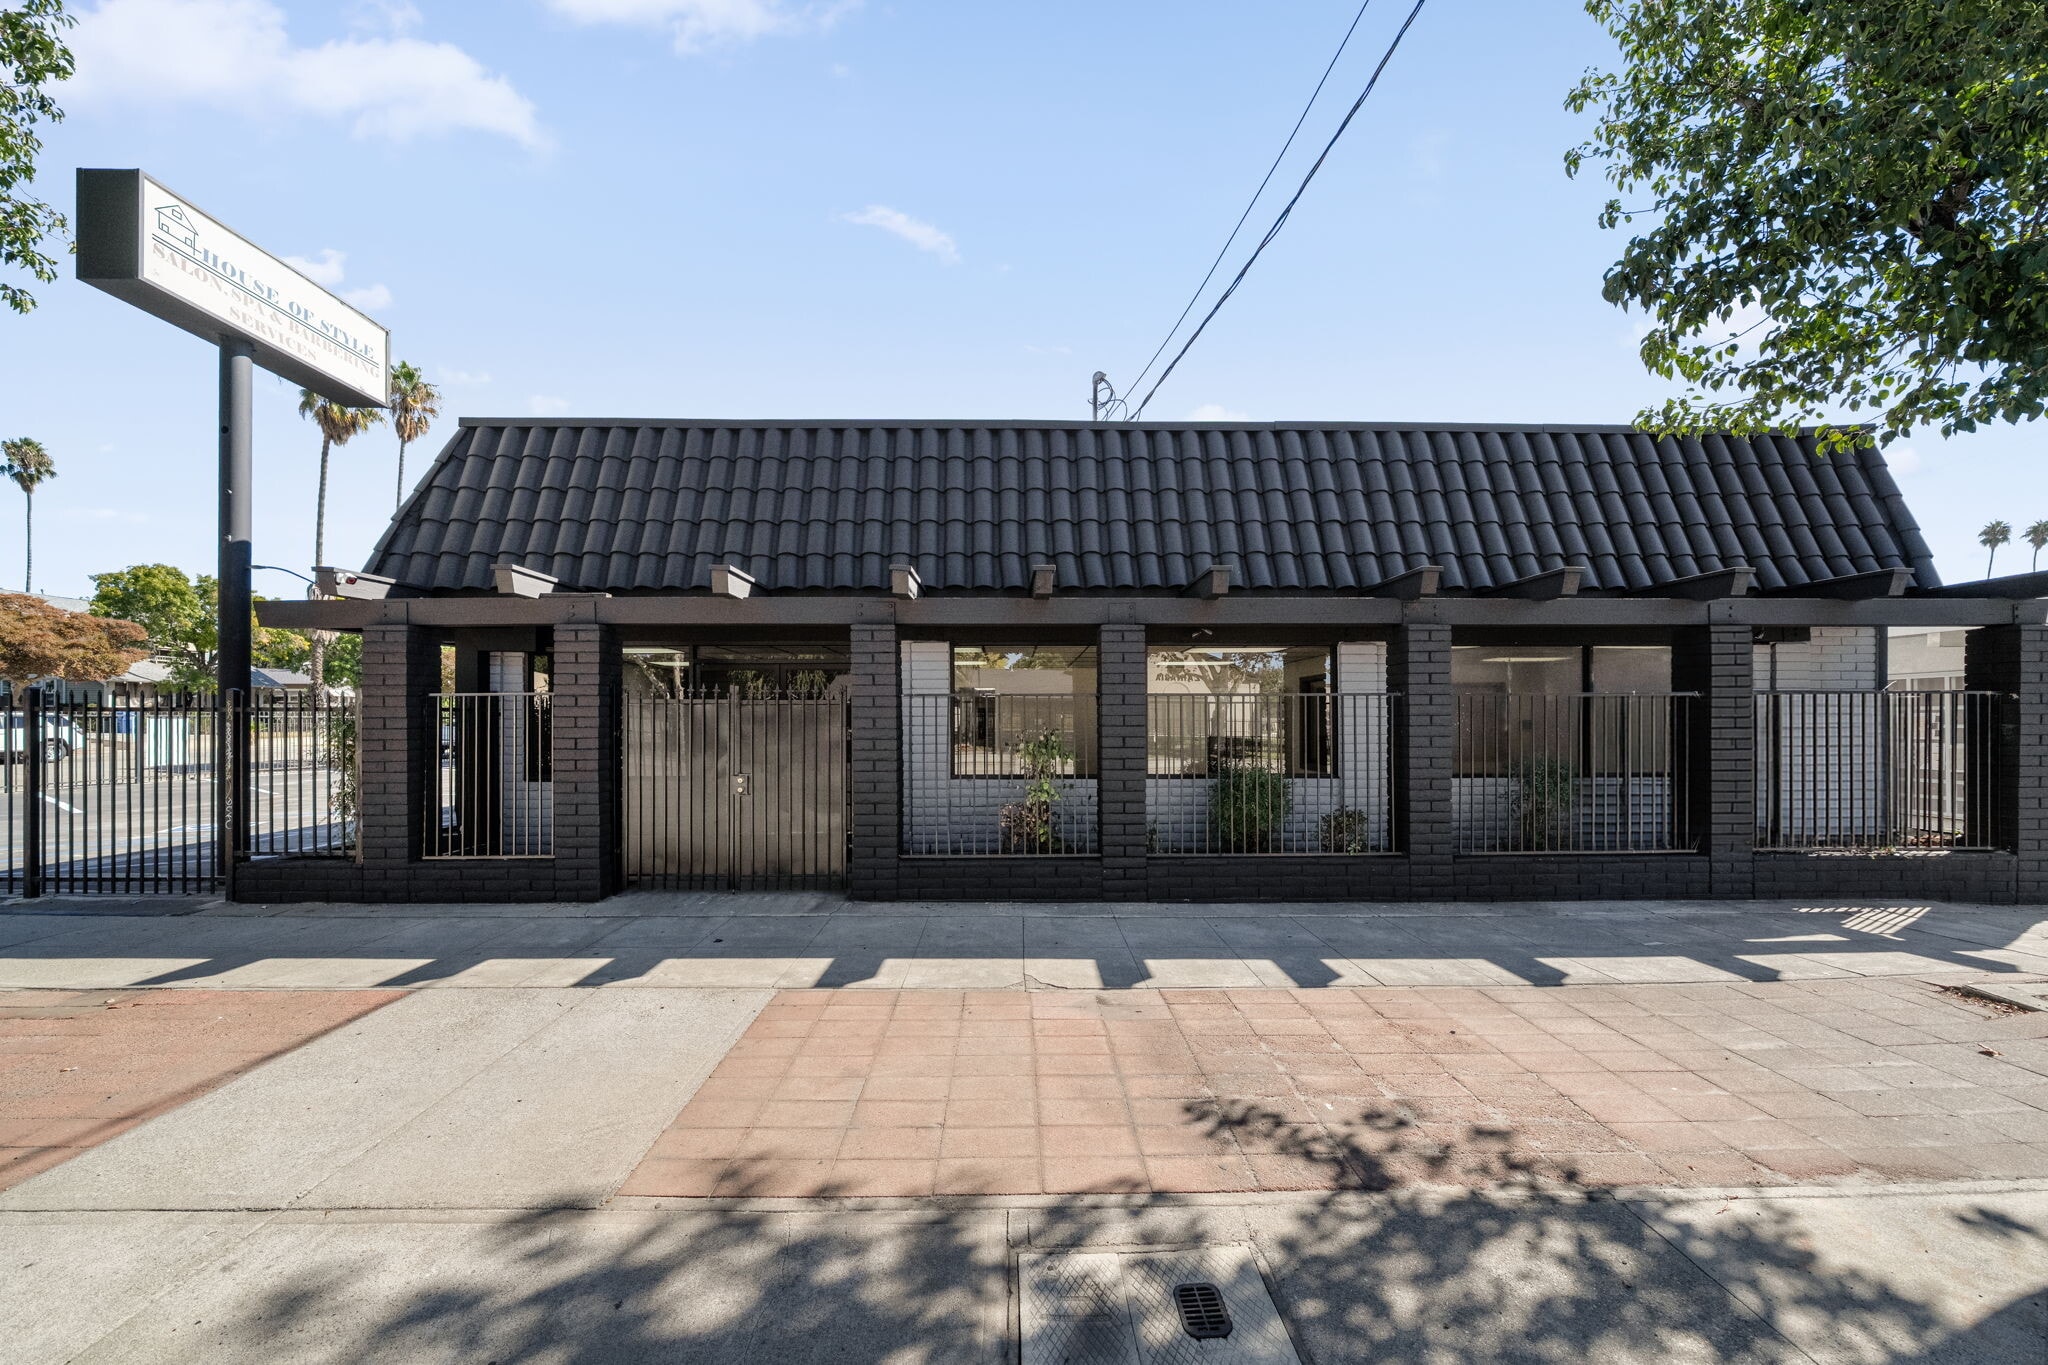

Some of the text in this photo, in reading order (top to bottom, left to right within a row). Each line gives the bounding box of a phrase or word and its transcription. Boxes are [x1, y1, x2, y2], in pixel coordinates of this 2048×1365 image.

[203, 248, 374, 360] HOUSE OF STYLE
[229, 306, 317, 361] SERVICES
[231, 288, 265, 316] SPA
[270, 310, 283, 327] &
[289, 319, 380, 378] BARBERING
